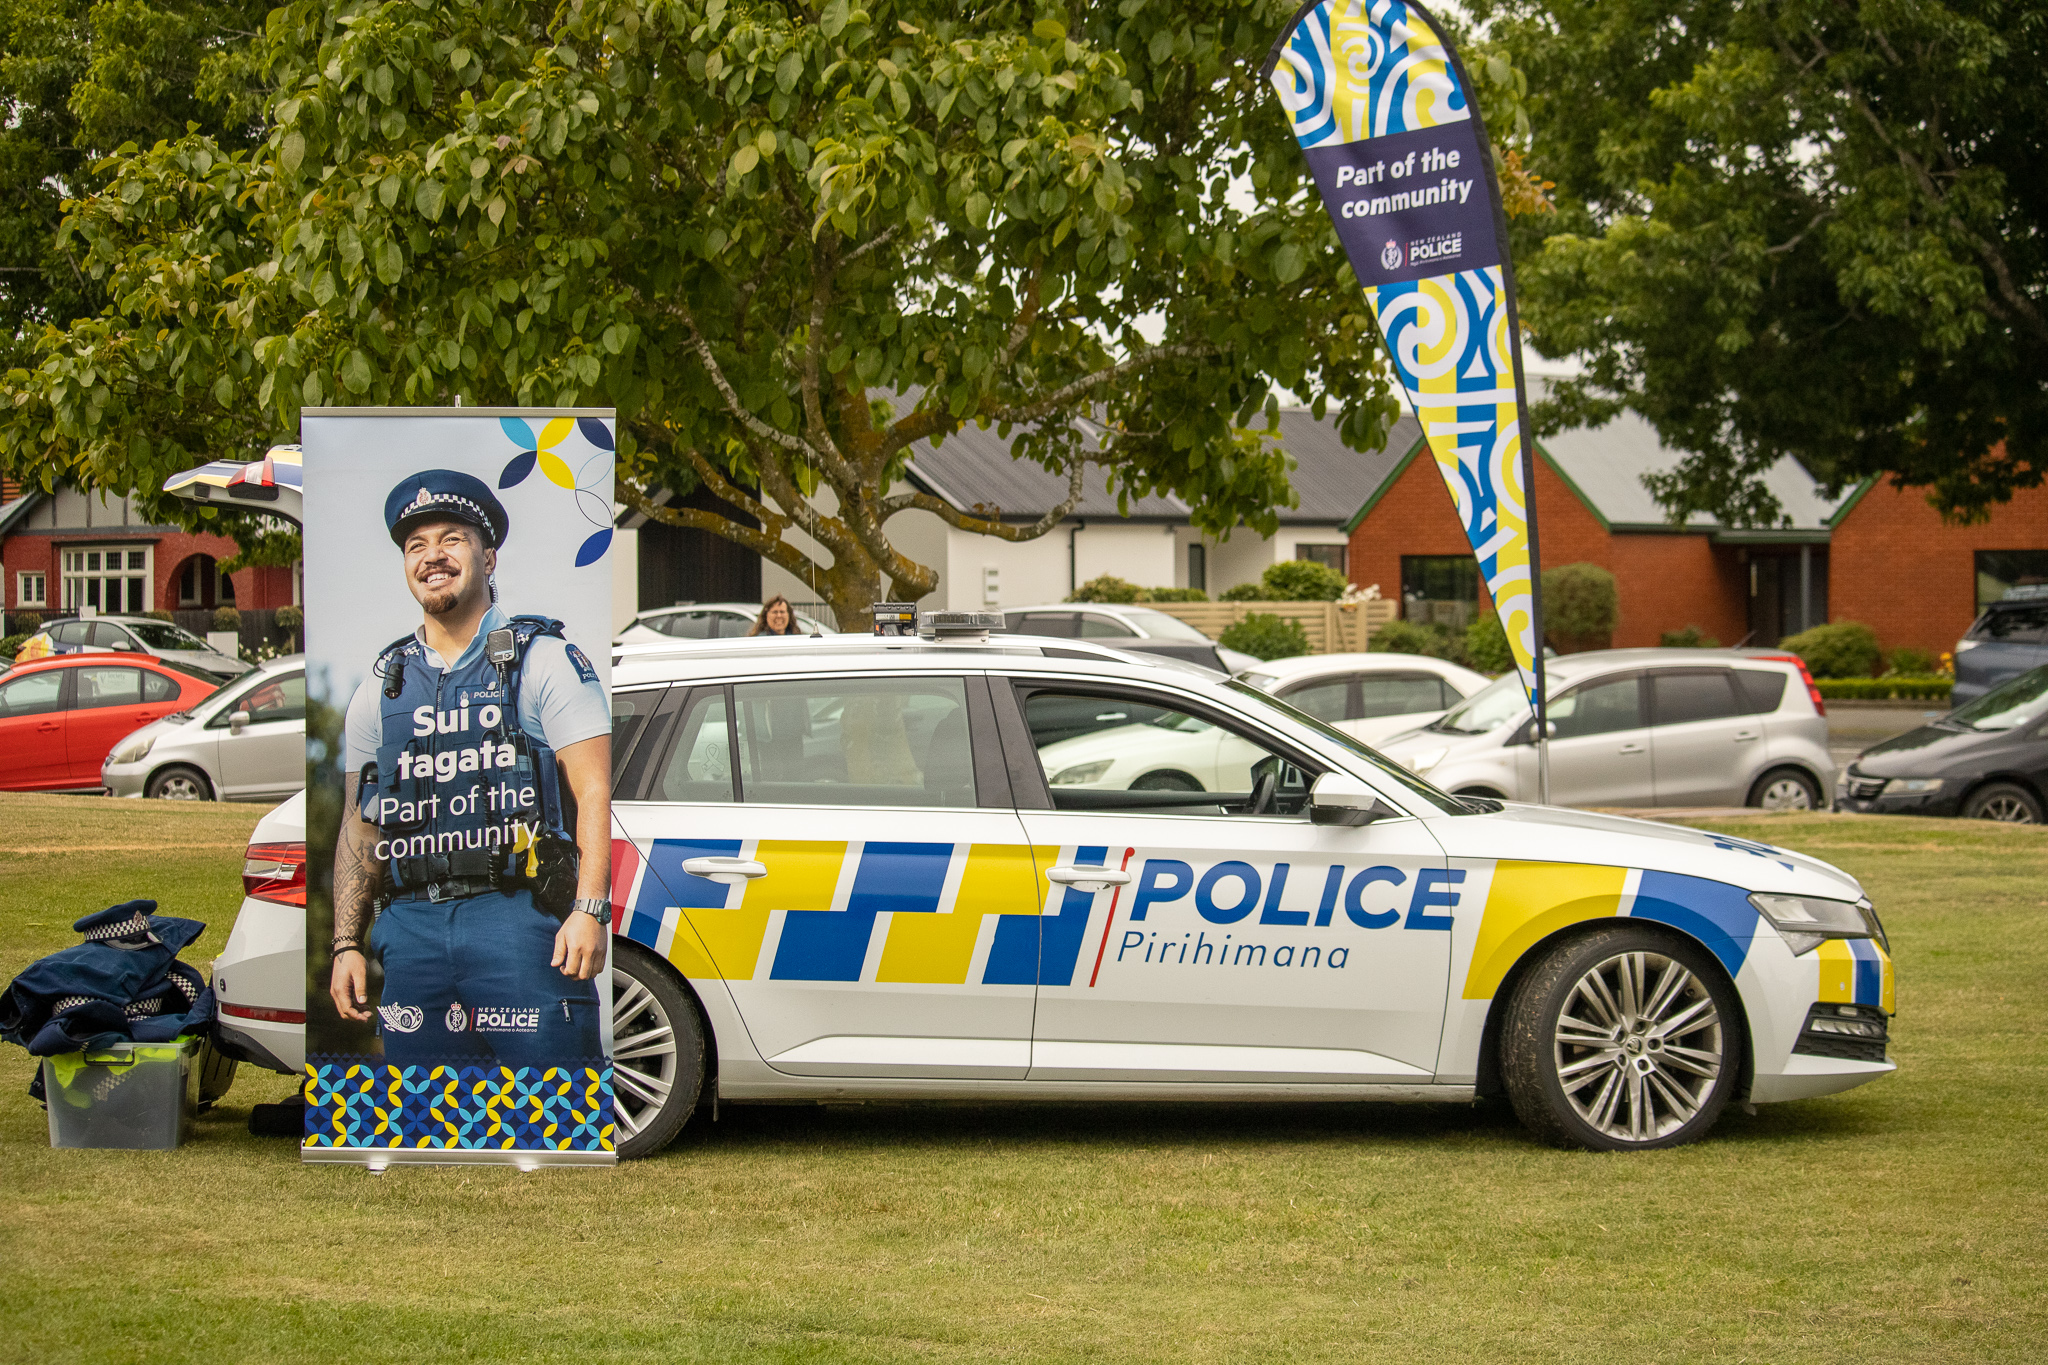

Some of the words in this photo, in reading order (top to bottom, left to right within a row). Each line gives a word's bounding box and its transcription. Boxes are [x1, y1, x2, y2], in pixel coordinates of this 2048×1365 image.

[1336, 160, 1386, 188] Part
[1390, 151, 1416, 179] of
[1421, 147, 1461, 173] the
[1341, 178, 1474, 219] community
[1410, 238, 1462, 261] POLICE
[413, 699, 469, 737] Sui
[478, 704, 501, 729] o
[398, 740, 516, 783] tagata
[380, 794, 441, 826] Part
[450, 784, 480, 816] of
[487, 782, 536, 811] the
[374, 818, 540, 861] community
[1129, 859, 1467, 931] POLICE
[1117, 931, 1350, 969] Pirihimana
[476, 1013, 539, 1027] POLICE
